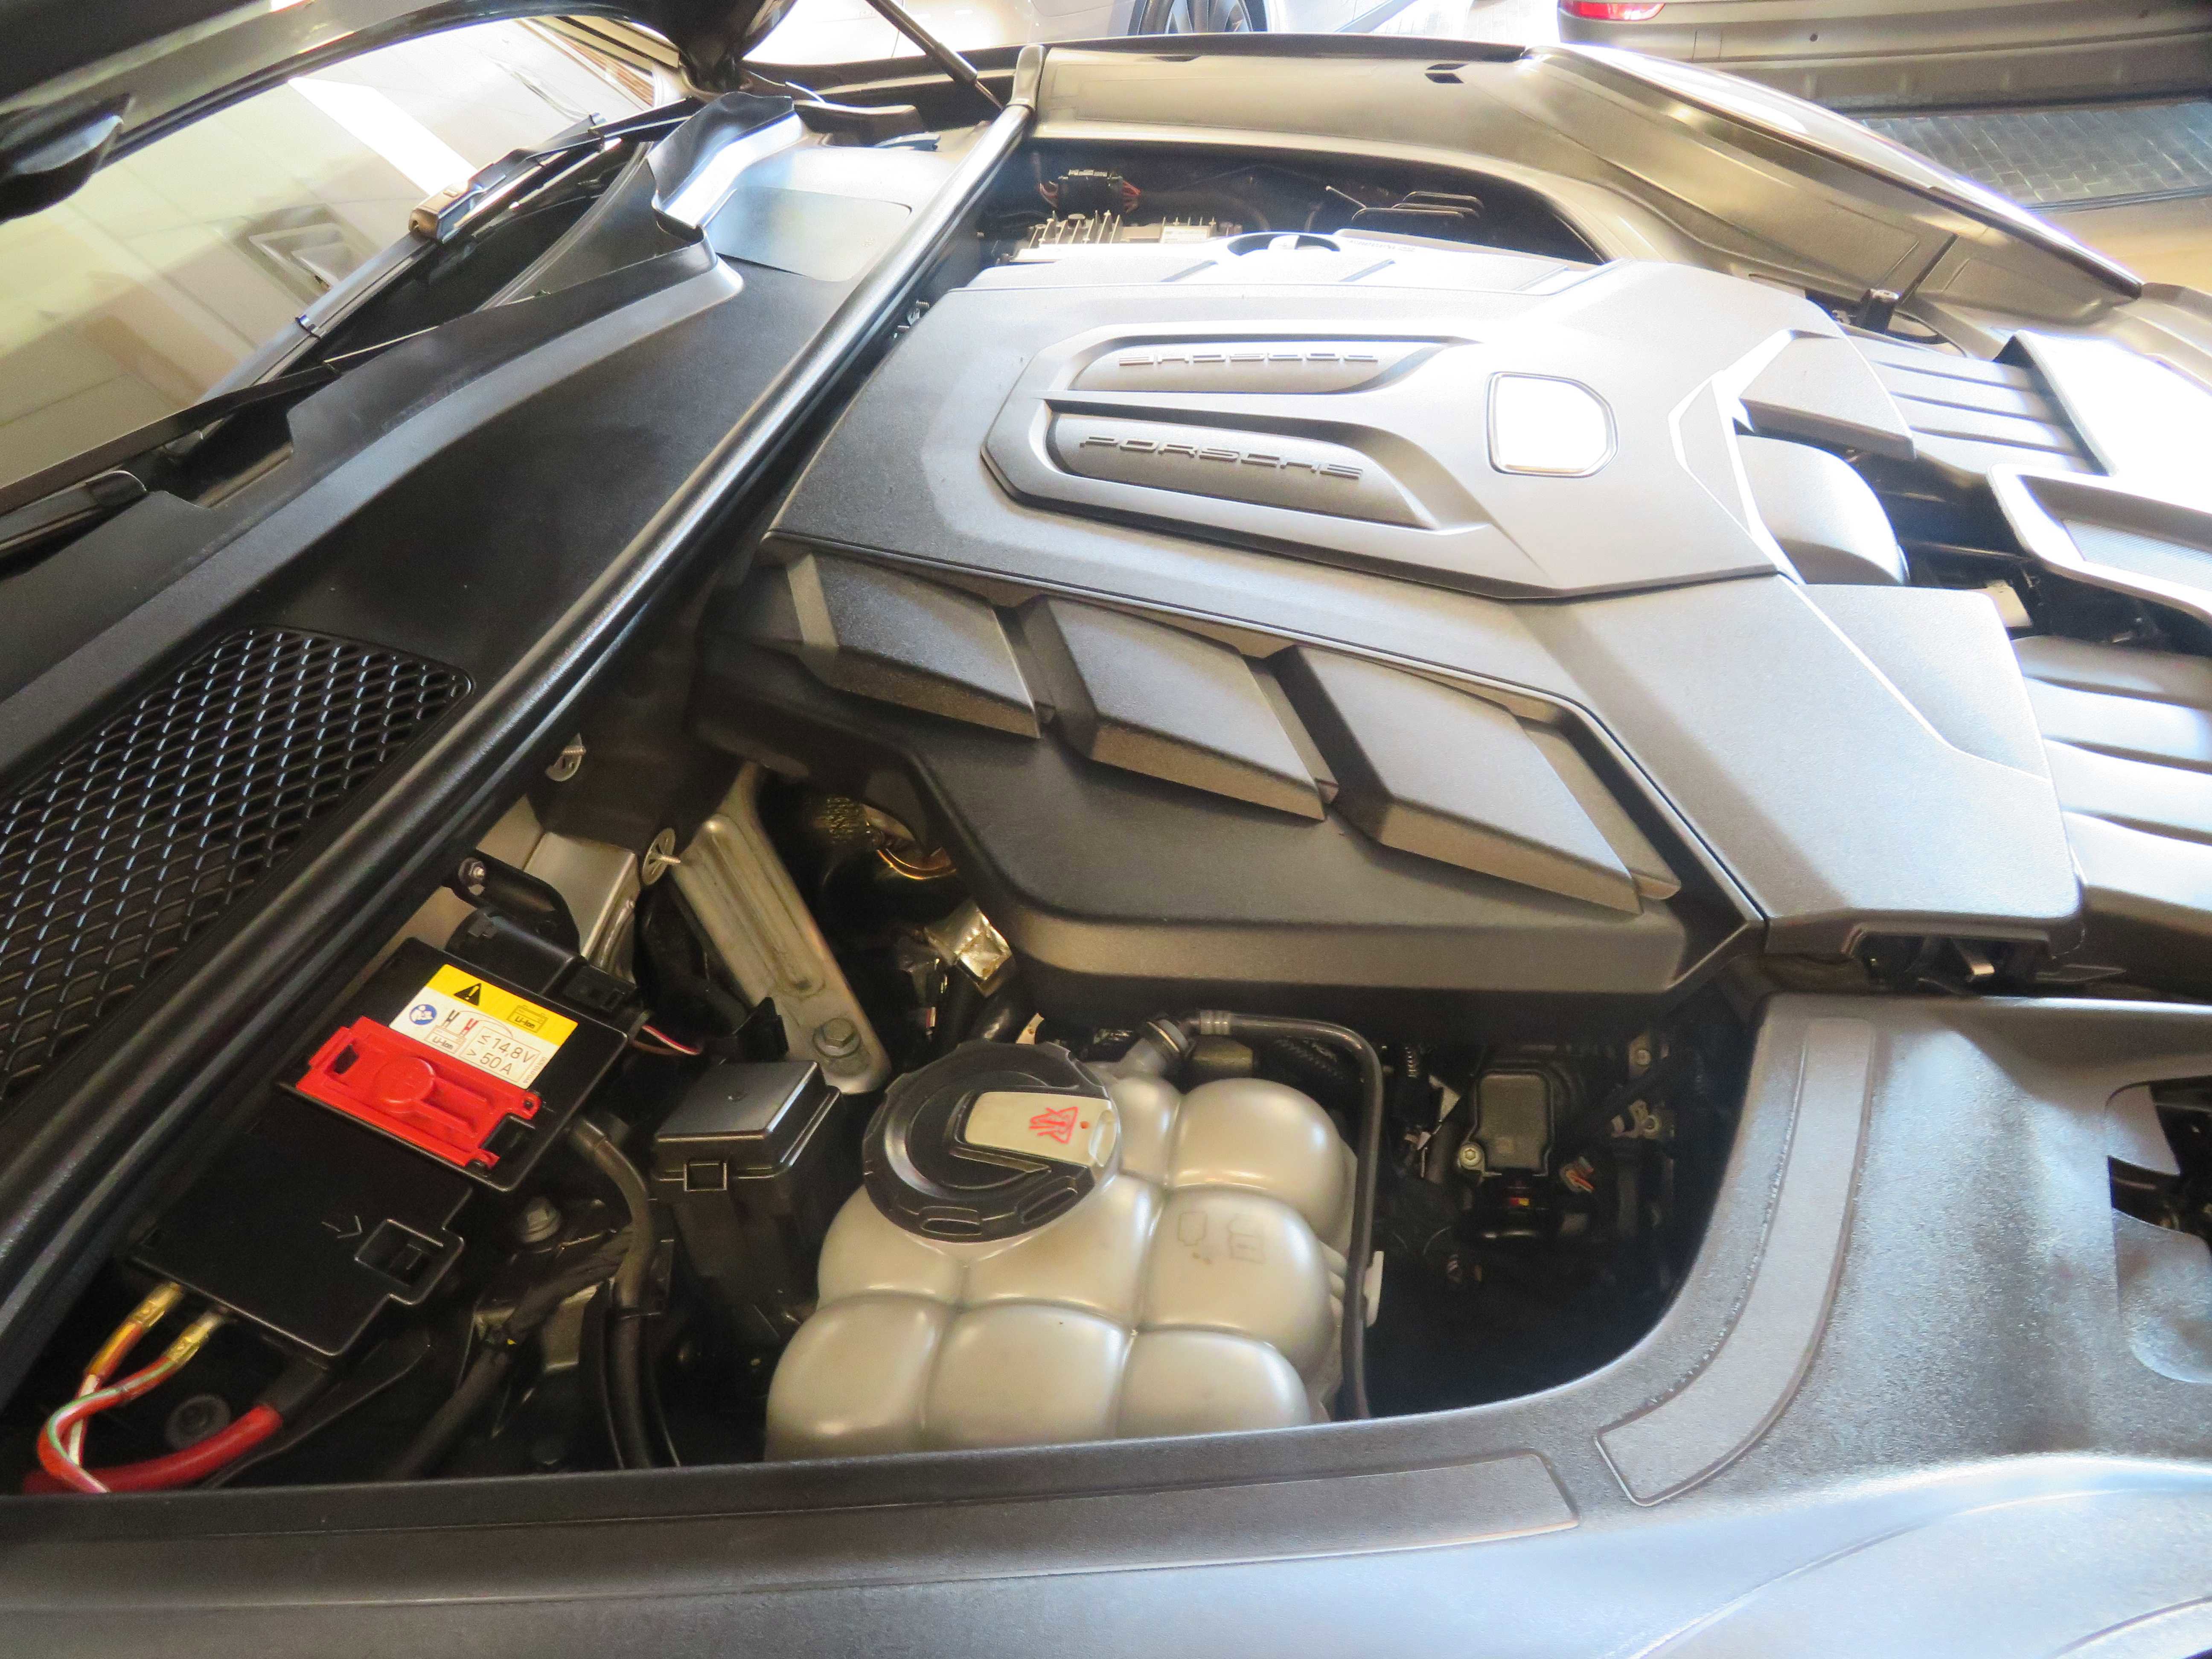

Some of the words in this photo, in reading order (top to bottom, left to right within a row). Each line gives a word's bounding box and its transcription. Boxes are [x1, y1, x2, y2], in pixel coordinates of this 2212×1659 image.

[1080, 435, 1363, 480] PORSCHE
[515, 1016, 535, 1029] Li-Ion
[432, 1036, 454, 1049] Li-Ion
